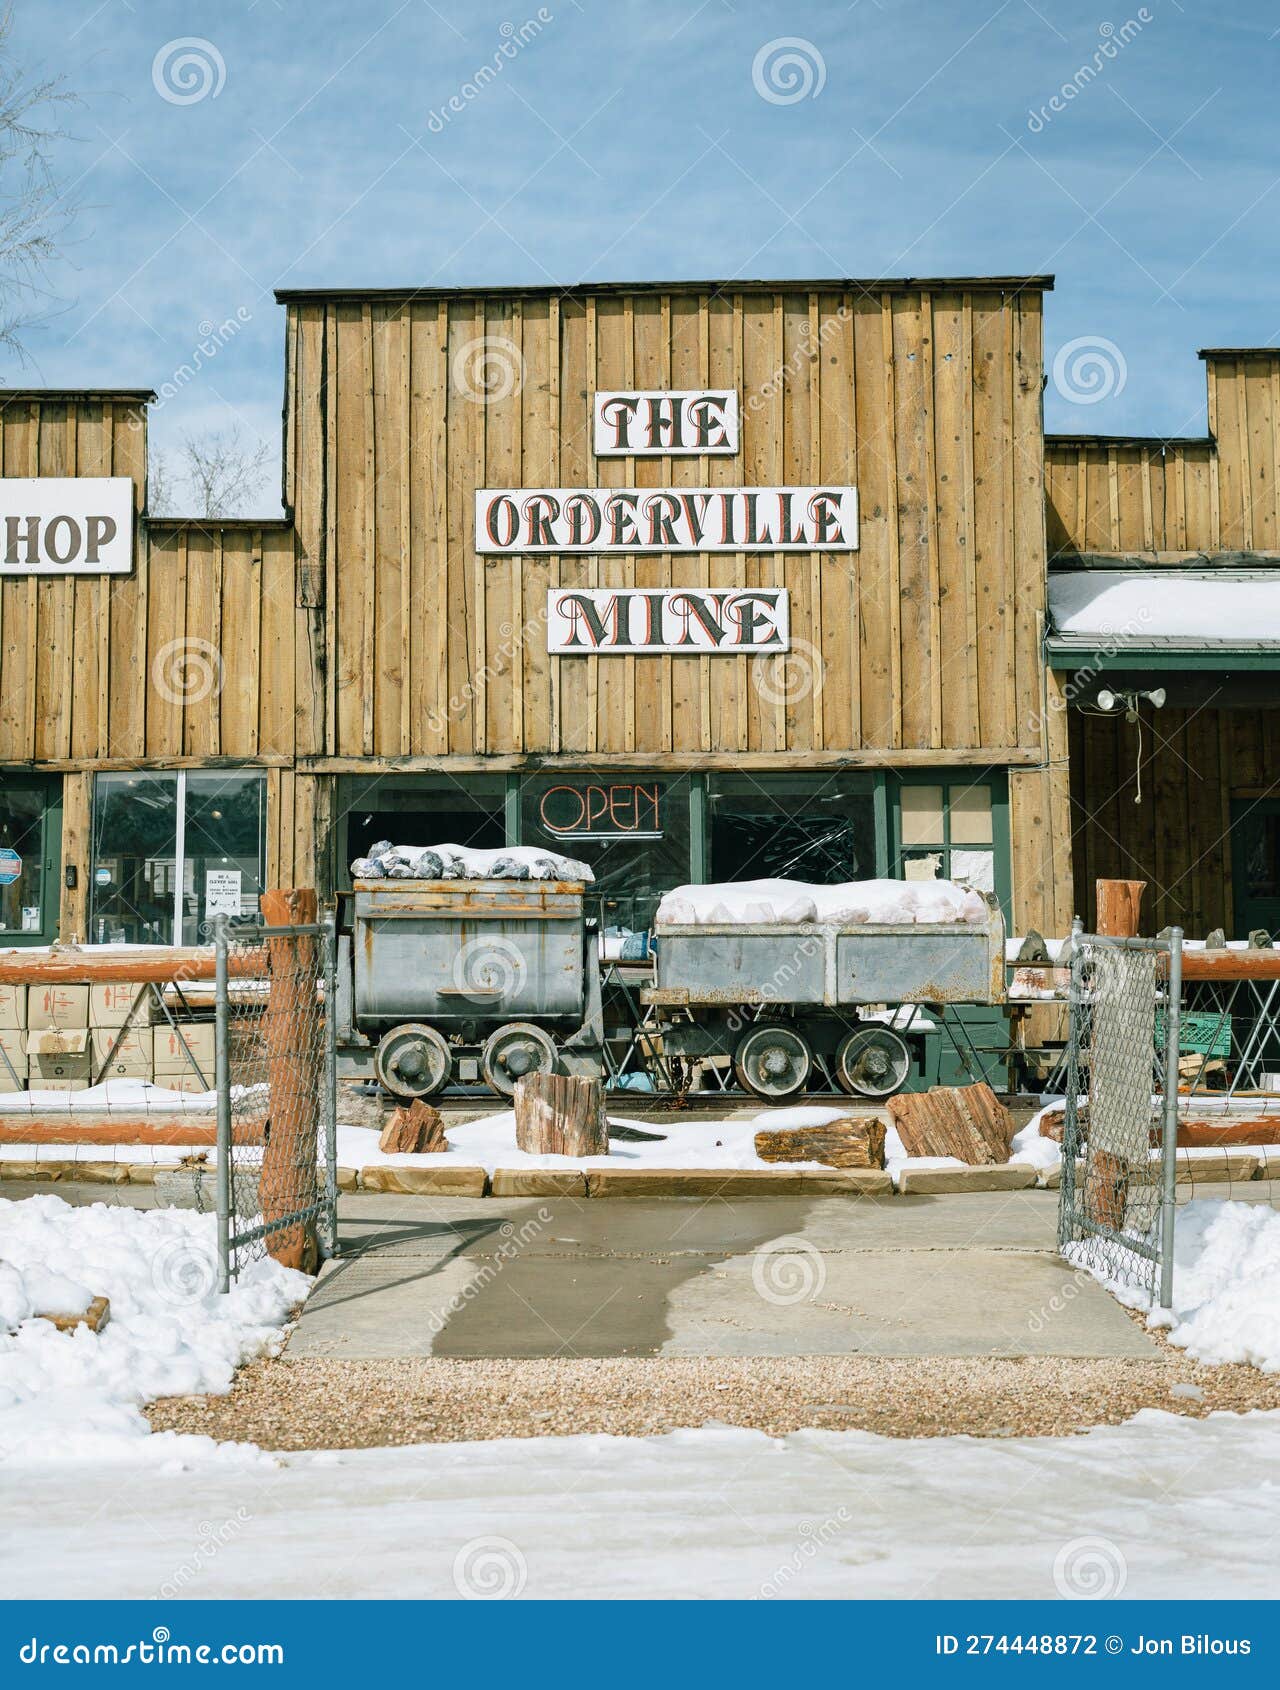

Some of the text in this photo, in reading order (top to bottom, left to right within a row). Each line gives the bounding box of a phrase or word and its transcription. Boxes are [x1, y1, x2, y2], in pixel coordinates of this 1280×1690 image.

[601, 396, 732, 450] THE
[0, 515, 117, 565] HOP
[486, 491, 846, 547] ORDERVILLE
[556, 591, 784, 648] MINE
[540, 784, 660, 831] OPEN
